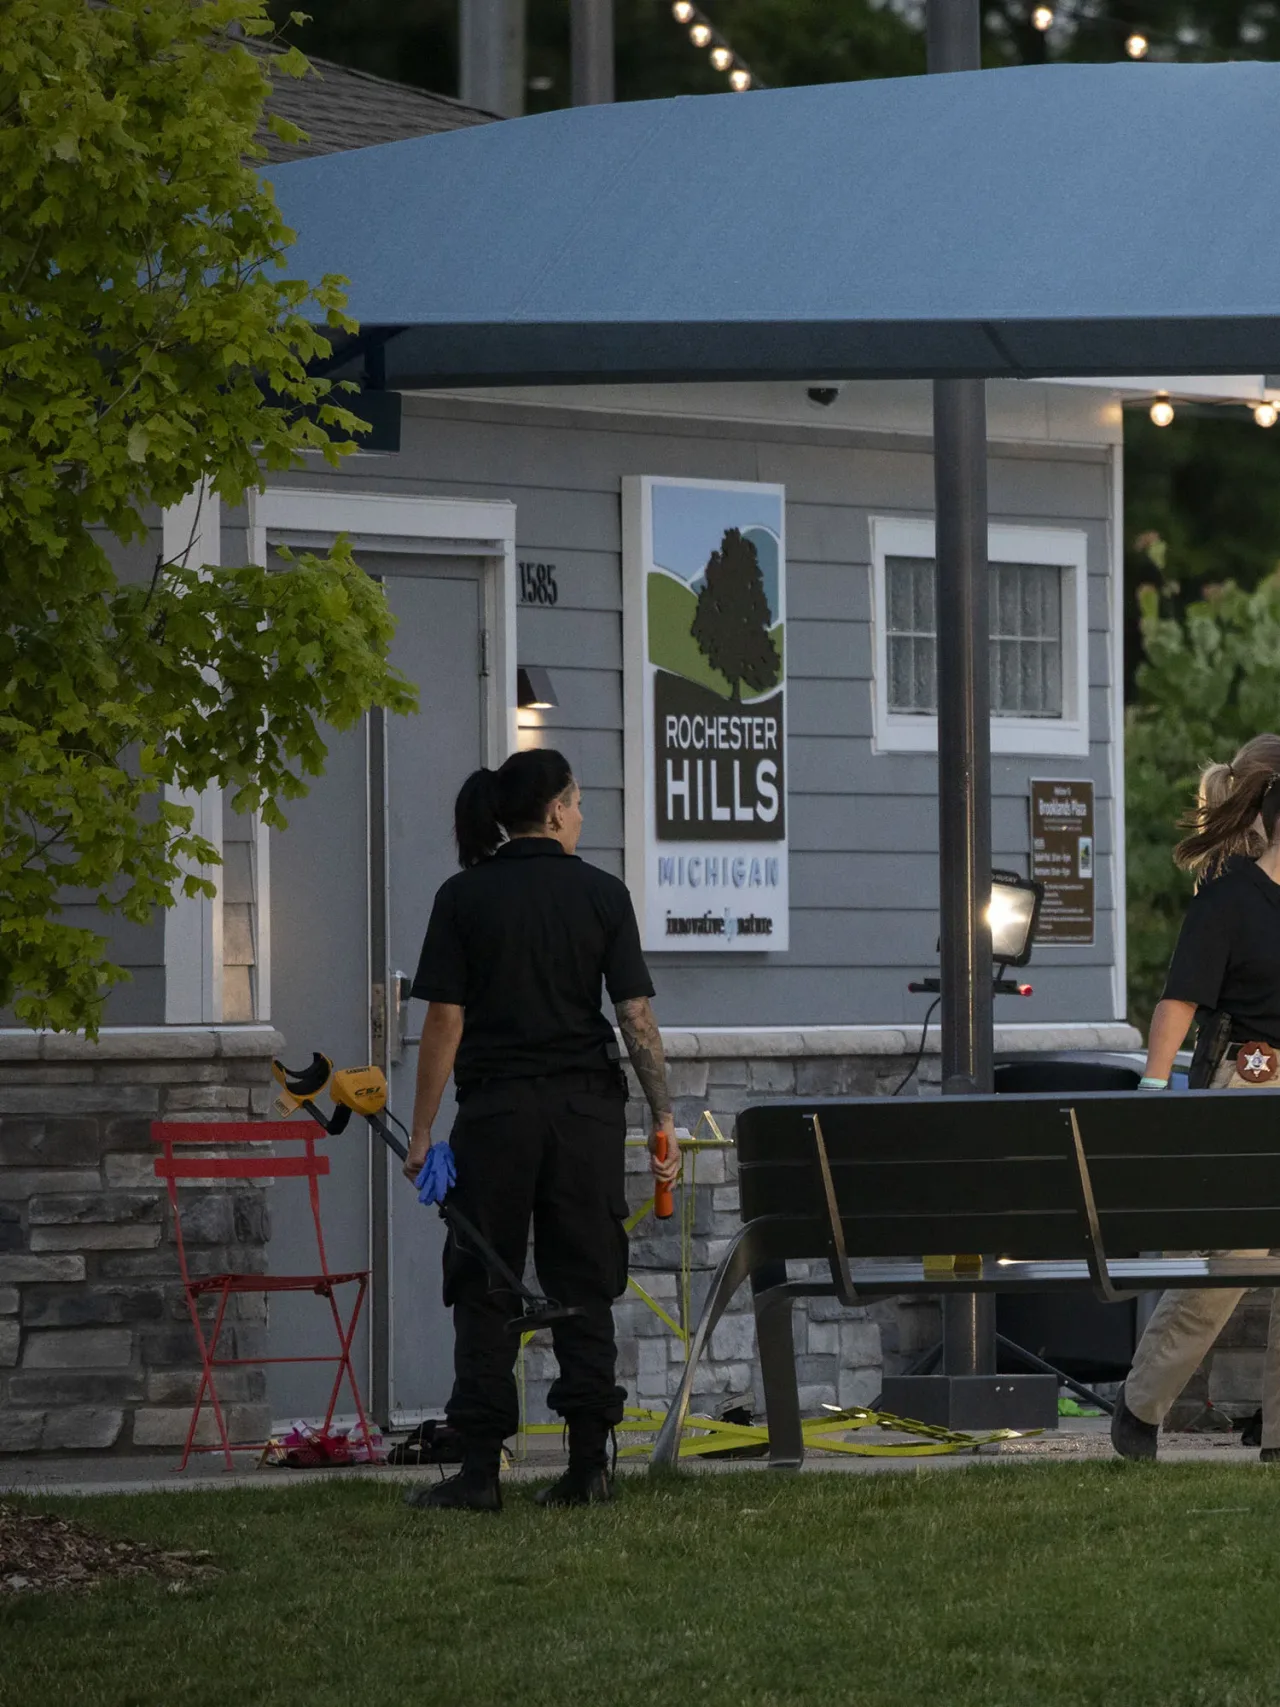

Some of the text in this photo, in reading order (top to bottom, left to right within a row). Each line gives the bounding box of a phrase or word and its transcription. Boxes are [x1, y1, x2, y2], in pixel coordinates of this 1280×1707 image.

[519, 562, 558, 605] 1585
[666, 715, 777, 750] ROCHESTER
[667, 758, 779, 823] HILLS
[659, 856, 779, 888] MICHIGAN
[666, 909, 724, 936] innovative
[737, 913, 773, 936] nature
[354, 1085, 381, 1096] CSI
